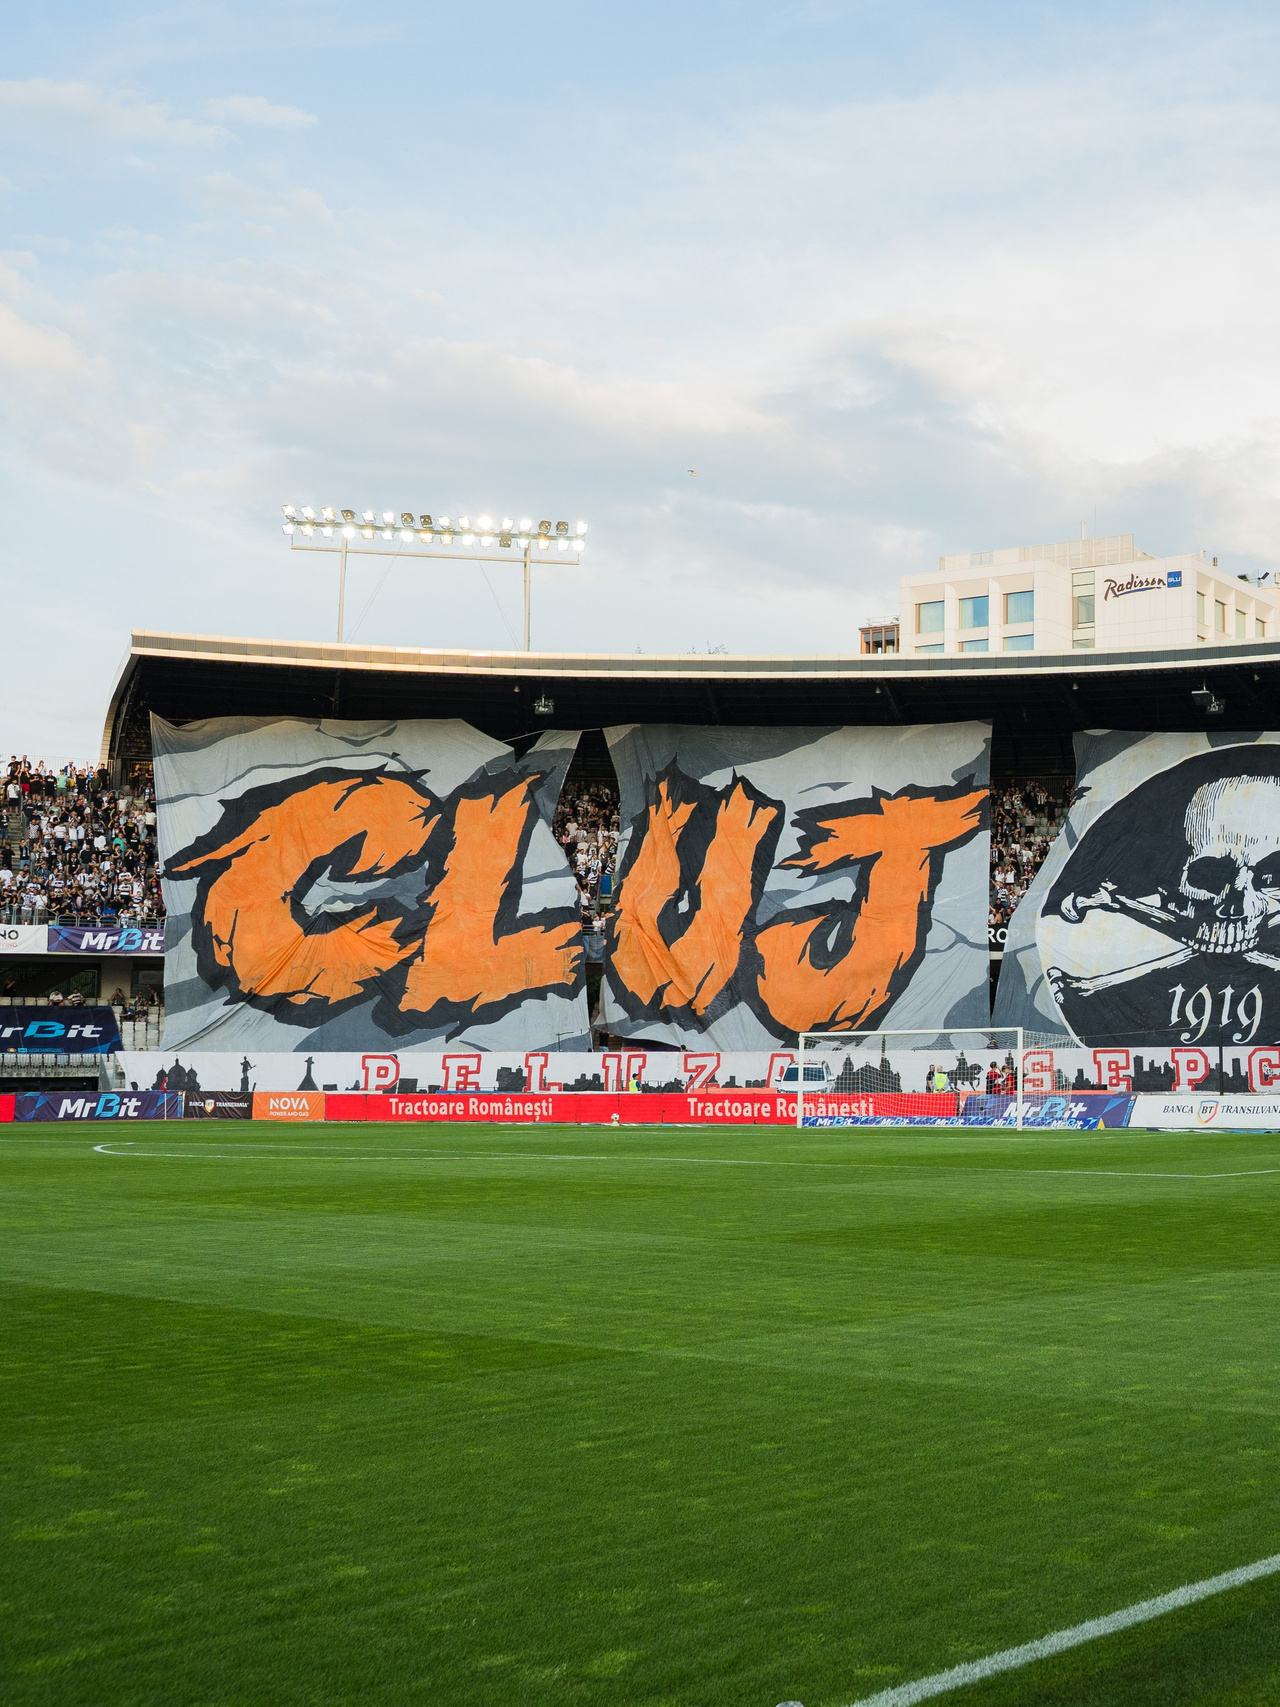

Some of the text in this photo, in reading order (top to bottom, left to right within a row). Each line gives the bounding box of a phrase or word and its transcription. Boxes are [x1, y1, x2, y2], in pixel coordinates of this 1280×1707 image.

[1104, 573, 1166, 601] Radisson
[171, 773, 990, 1031] CLUJ
[80, 928, 165, 950] MrBit
[1168, 982, 1263, 1044] 1919
[0, 1021, 103, 1038] rBit
[58, 1093, 141, 1118] MrBit
[270, 1097, 309, 1110] NOVA
[389, 1098, 464, 1115] Tractoare
[687, 1098, 770, 1116] Tractoare
[1162, 1105, 1194, 1114] BANCA
[1201, 1106, 1215, 1114] BT
[816, 1116, 854, 1127] MrBit
